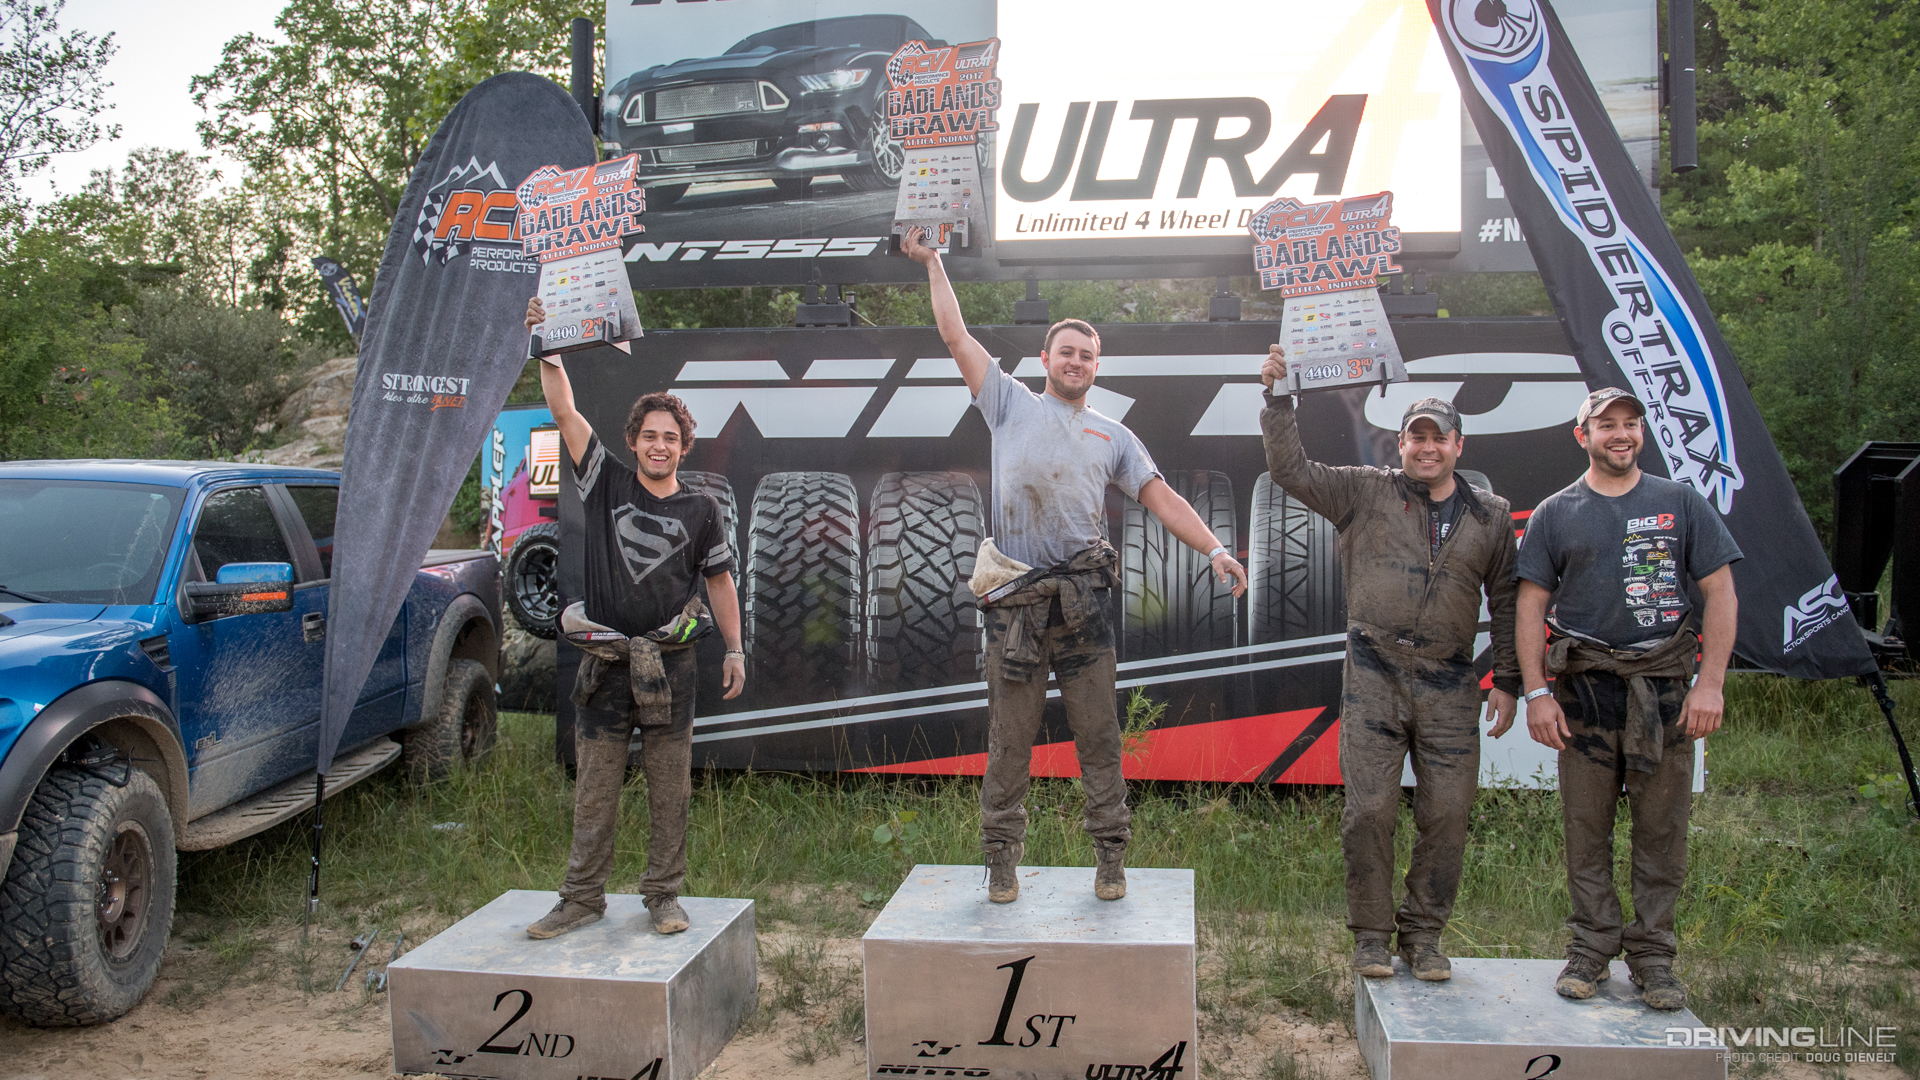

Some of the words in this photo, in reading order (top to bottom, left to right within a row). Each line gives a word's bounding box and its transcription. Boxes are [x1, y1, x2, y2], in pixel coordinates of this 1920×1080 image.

[900, 49, 951, 75] RCV
[959, 71, 984, 82] 2017
[889, 81, 999, 118] BADLANDS
[891, 109, 996, 139] BRAWL
[939, 134, 974, 144] INDIANA
[532, 168, 588, 197] RCV
[598, 183, 625, 195] 2017
[433, 189, 522, 243] RC
[520, 188, 642, 237] BADLANDS
[1015, 212, 1127, 233] Unlimited
[1135, 211, 1149, 229] 4
[1160, 210, 1218, 229] Wheel
[1266, 203, 1333, 231] RCV
[1347, 221, 1379, 232] 2017
[524, 215, 641, 256] BRAWL
[579, 239, 618, 253] INDIANA
[623, 237, 883, 262] NT555
[1255, 228, 1400, 270] BADLANDS
[470, 259, 537, 273] PRODUCTS
[1261, 255, 1401, 289] BRAWL
[1328, 278, 1375, 290] INDIANA
[1522, 84, 1738, 487] SPIDERTRAX
[547, 324, 578, 342] 4400
[1305, 364, 1342, 381] 4400
[1347, 357, 1373, 379] 3RD
[531, 465, 559, 486] UL
[490, 429, 506, 566] APPLER
[1783, 635, 1805, 655] ACTION
[1804, 618, 1831, 639] SPORTS
[1831, 603, 1850, 620] CANO
[978, 955, 1076, 1048] 1ST
[477, 989, 575, 1058] 2ND
